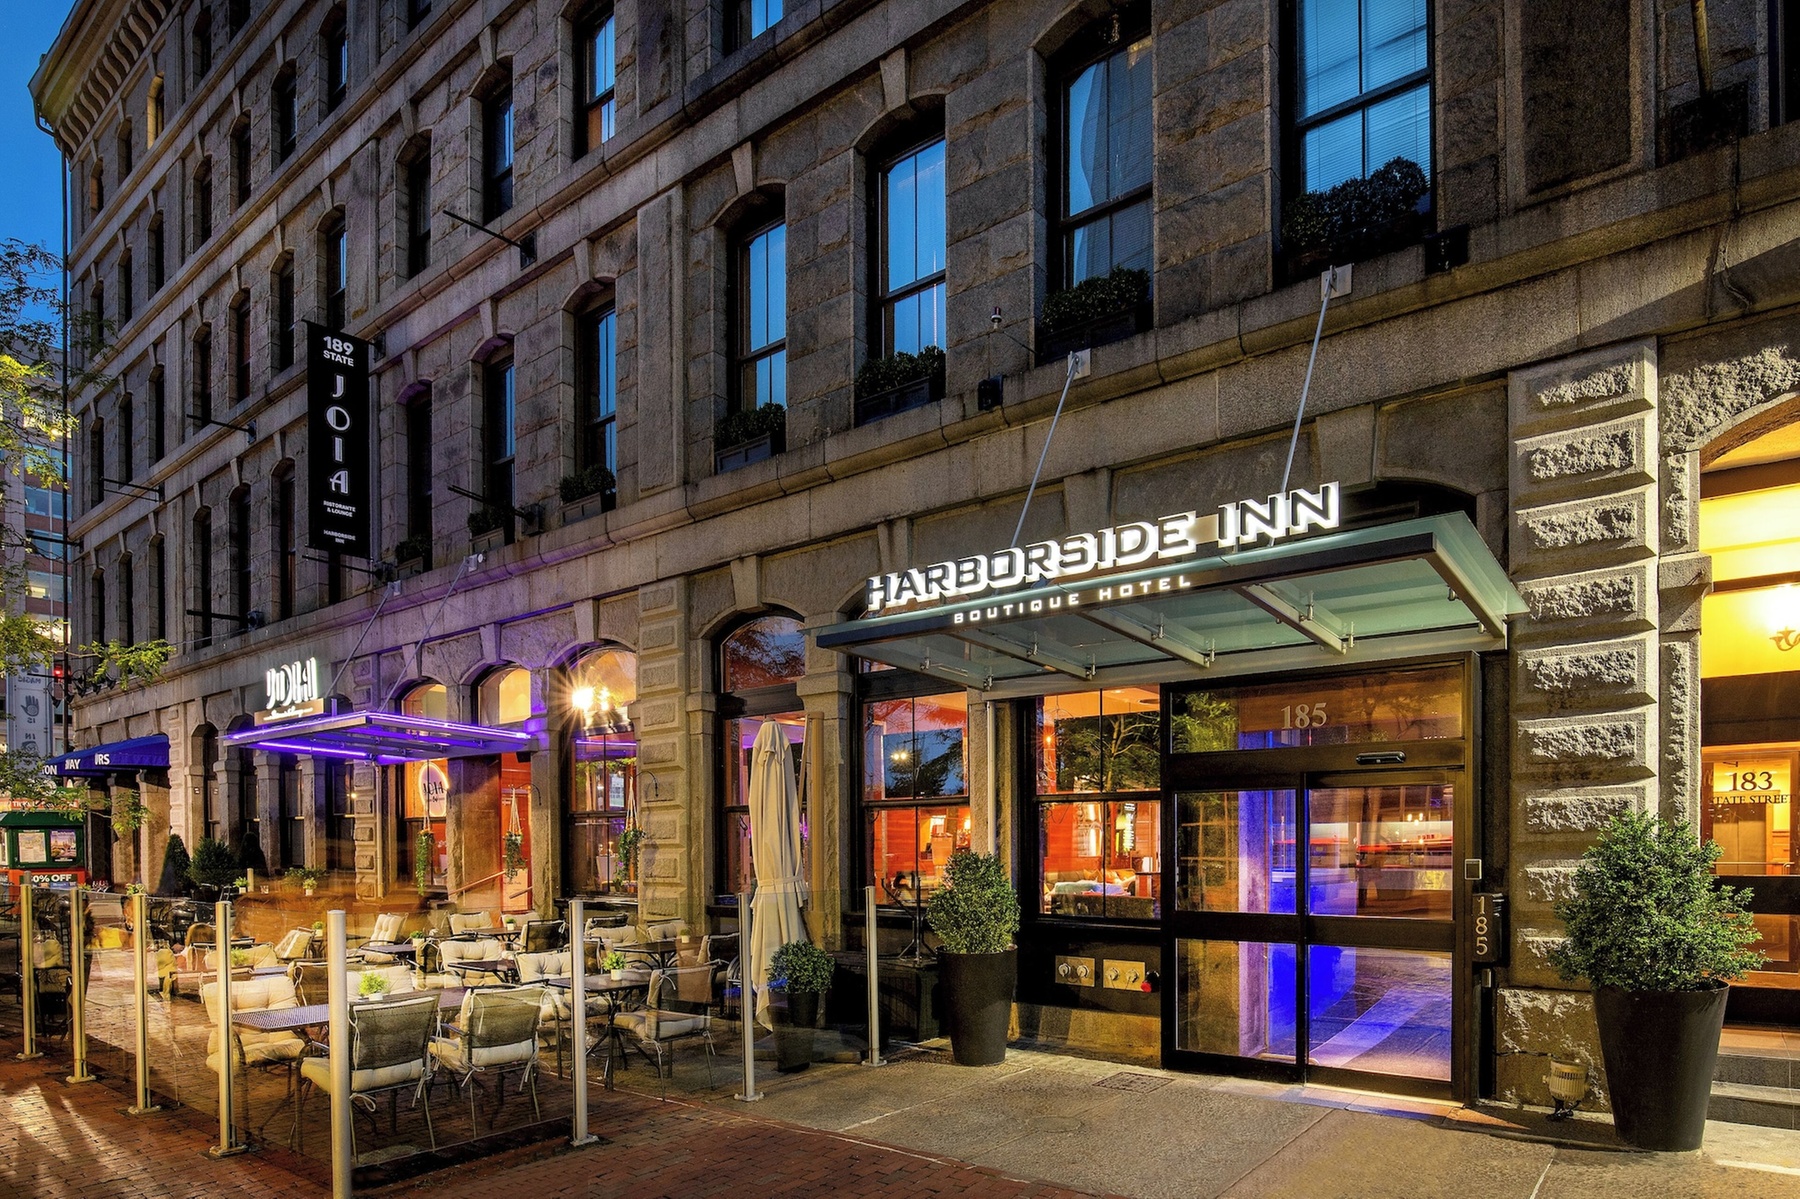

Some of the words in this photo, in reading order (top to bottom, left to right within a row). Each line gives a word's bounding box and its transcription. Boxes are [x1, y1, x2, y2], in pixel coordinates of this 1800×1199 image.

[323, 336, 354, 355] 189
[323, 350, 354, 367] STATE
[325, 374, 351, 494] JOIA
[323, 500, 356, 512] RISTORANTE
[331, 508, 353, 517] LOUNGE
[323, 529, 356, 541] HARBORSIDE
[866, 510, 1197, 612] HARBORSIDE
[1217, 481, 1340, 549] INN
[954, 593, 1080, 624] BOUTIQUE
[1099, 575, 1191, 600] HOTEL
[1280, 702, 1327, 729] 185
[1729, 771, 1773, 791] 183
[31, 874, 50, 883] 0%
[51, 874, 72, 882] OFF
[1476, 896, 1488, 955] 185
